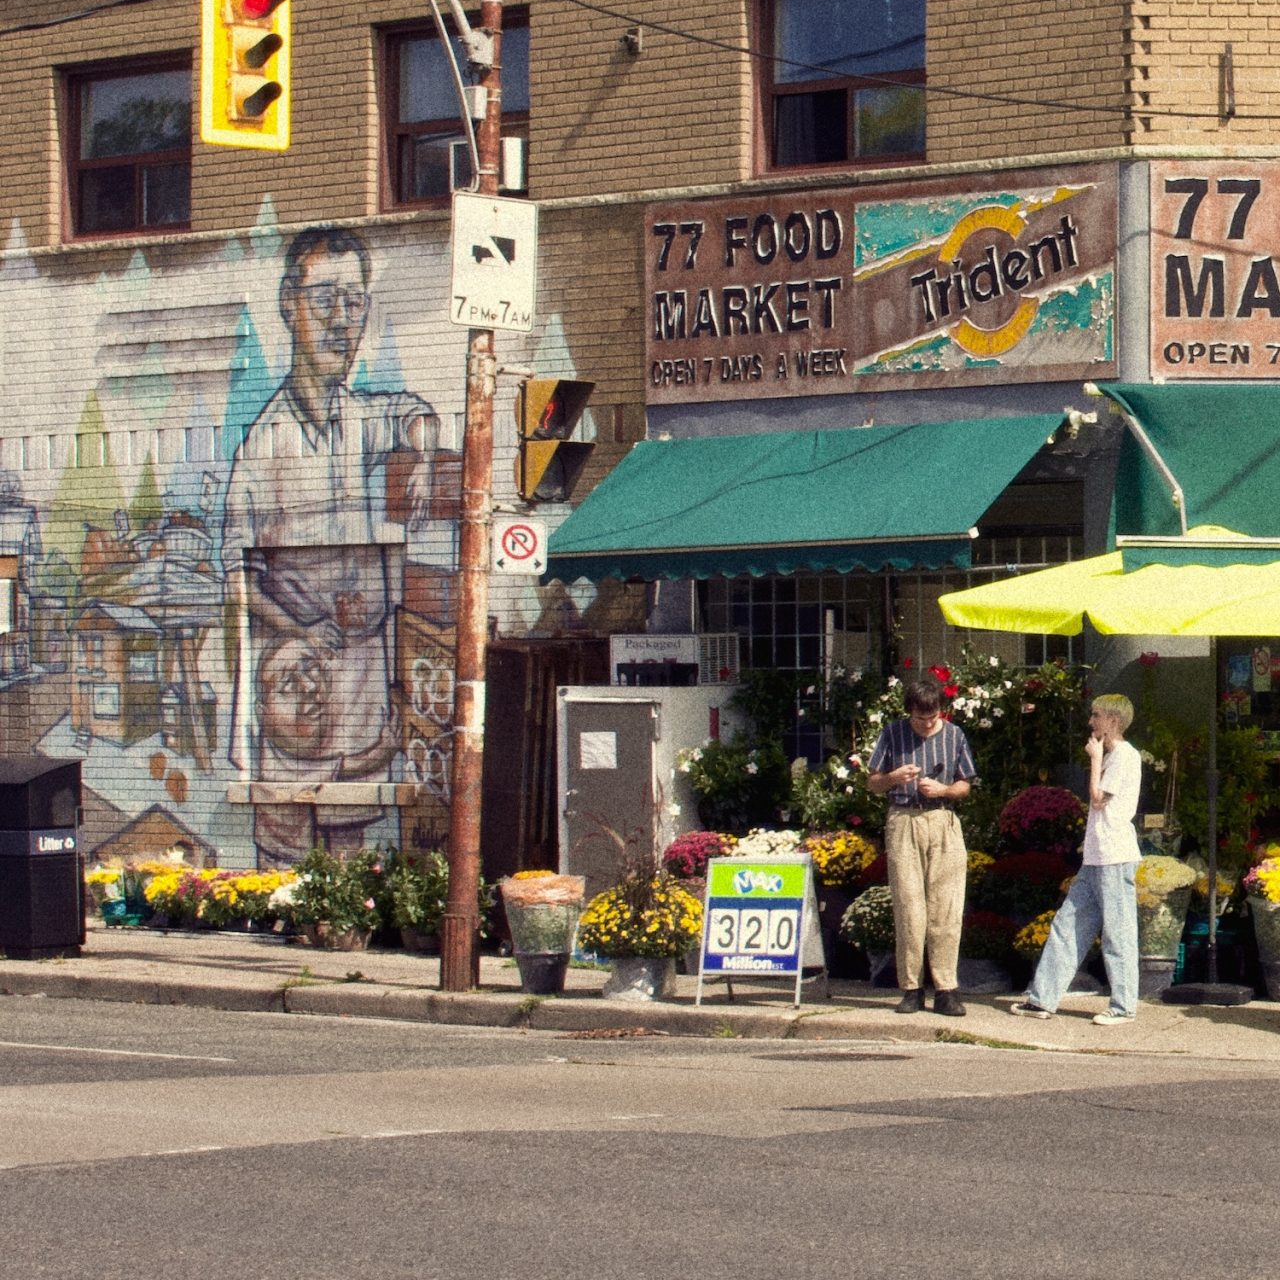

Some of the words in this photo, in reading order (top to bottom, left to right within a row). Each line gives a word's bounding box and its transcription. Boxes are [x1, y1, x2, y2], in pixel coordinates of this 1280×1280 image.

[1164, 176, 1261, 241] 77
[653, 221, 706, 271] 77
[725, 208, 844, 267] FOOD
[910, 213, 1080, 324] Trident
[654, 276, 844, 342] MARKET
[651, 357, 697, 386] OPEN
[702, 357, 714, 384] 7
[720, 353, 764, 383] DAYS
[777, 352, 789, 380] A
[796, 348, 848, 377] WEEK
[1163, 340, 1251, 366] OPEN
[624, 639, 682, 651] Packaged
[38, 836, 64, 852] Litter
[722, 955, 773, 971] Million
